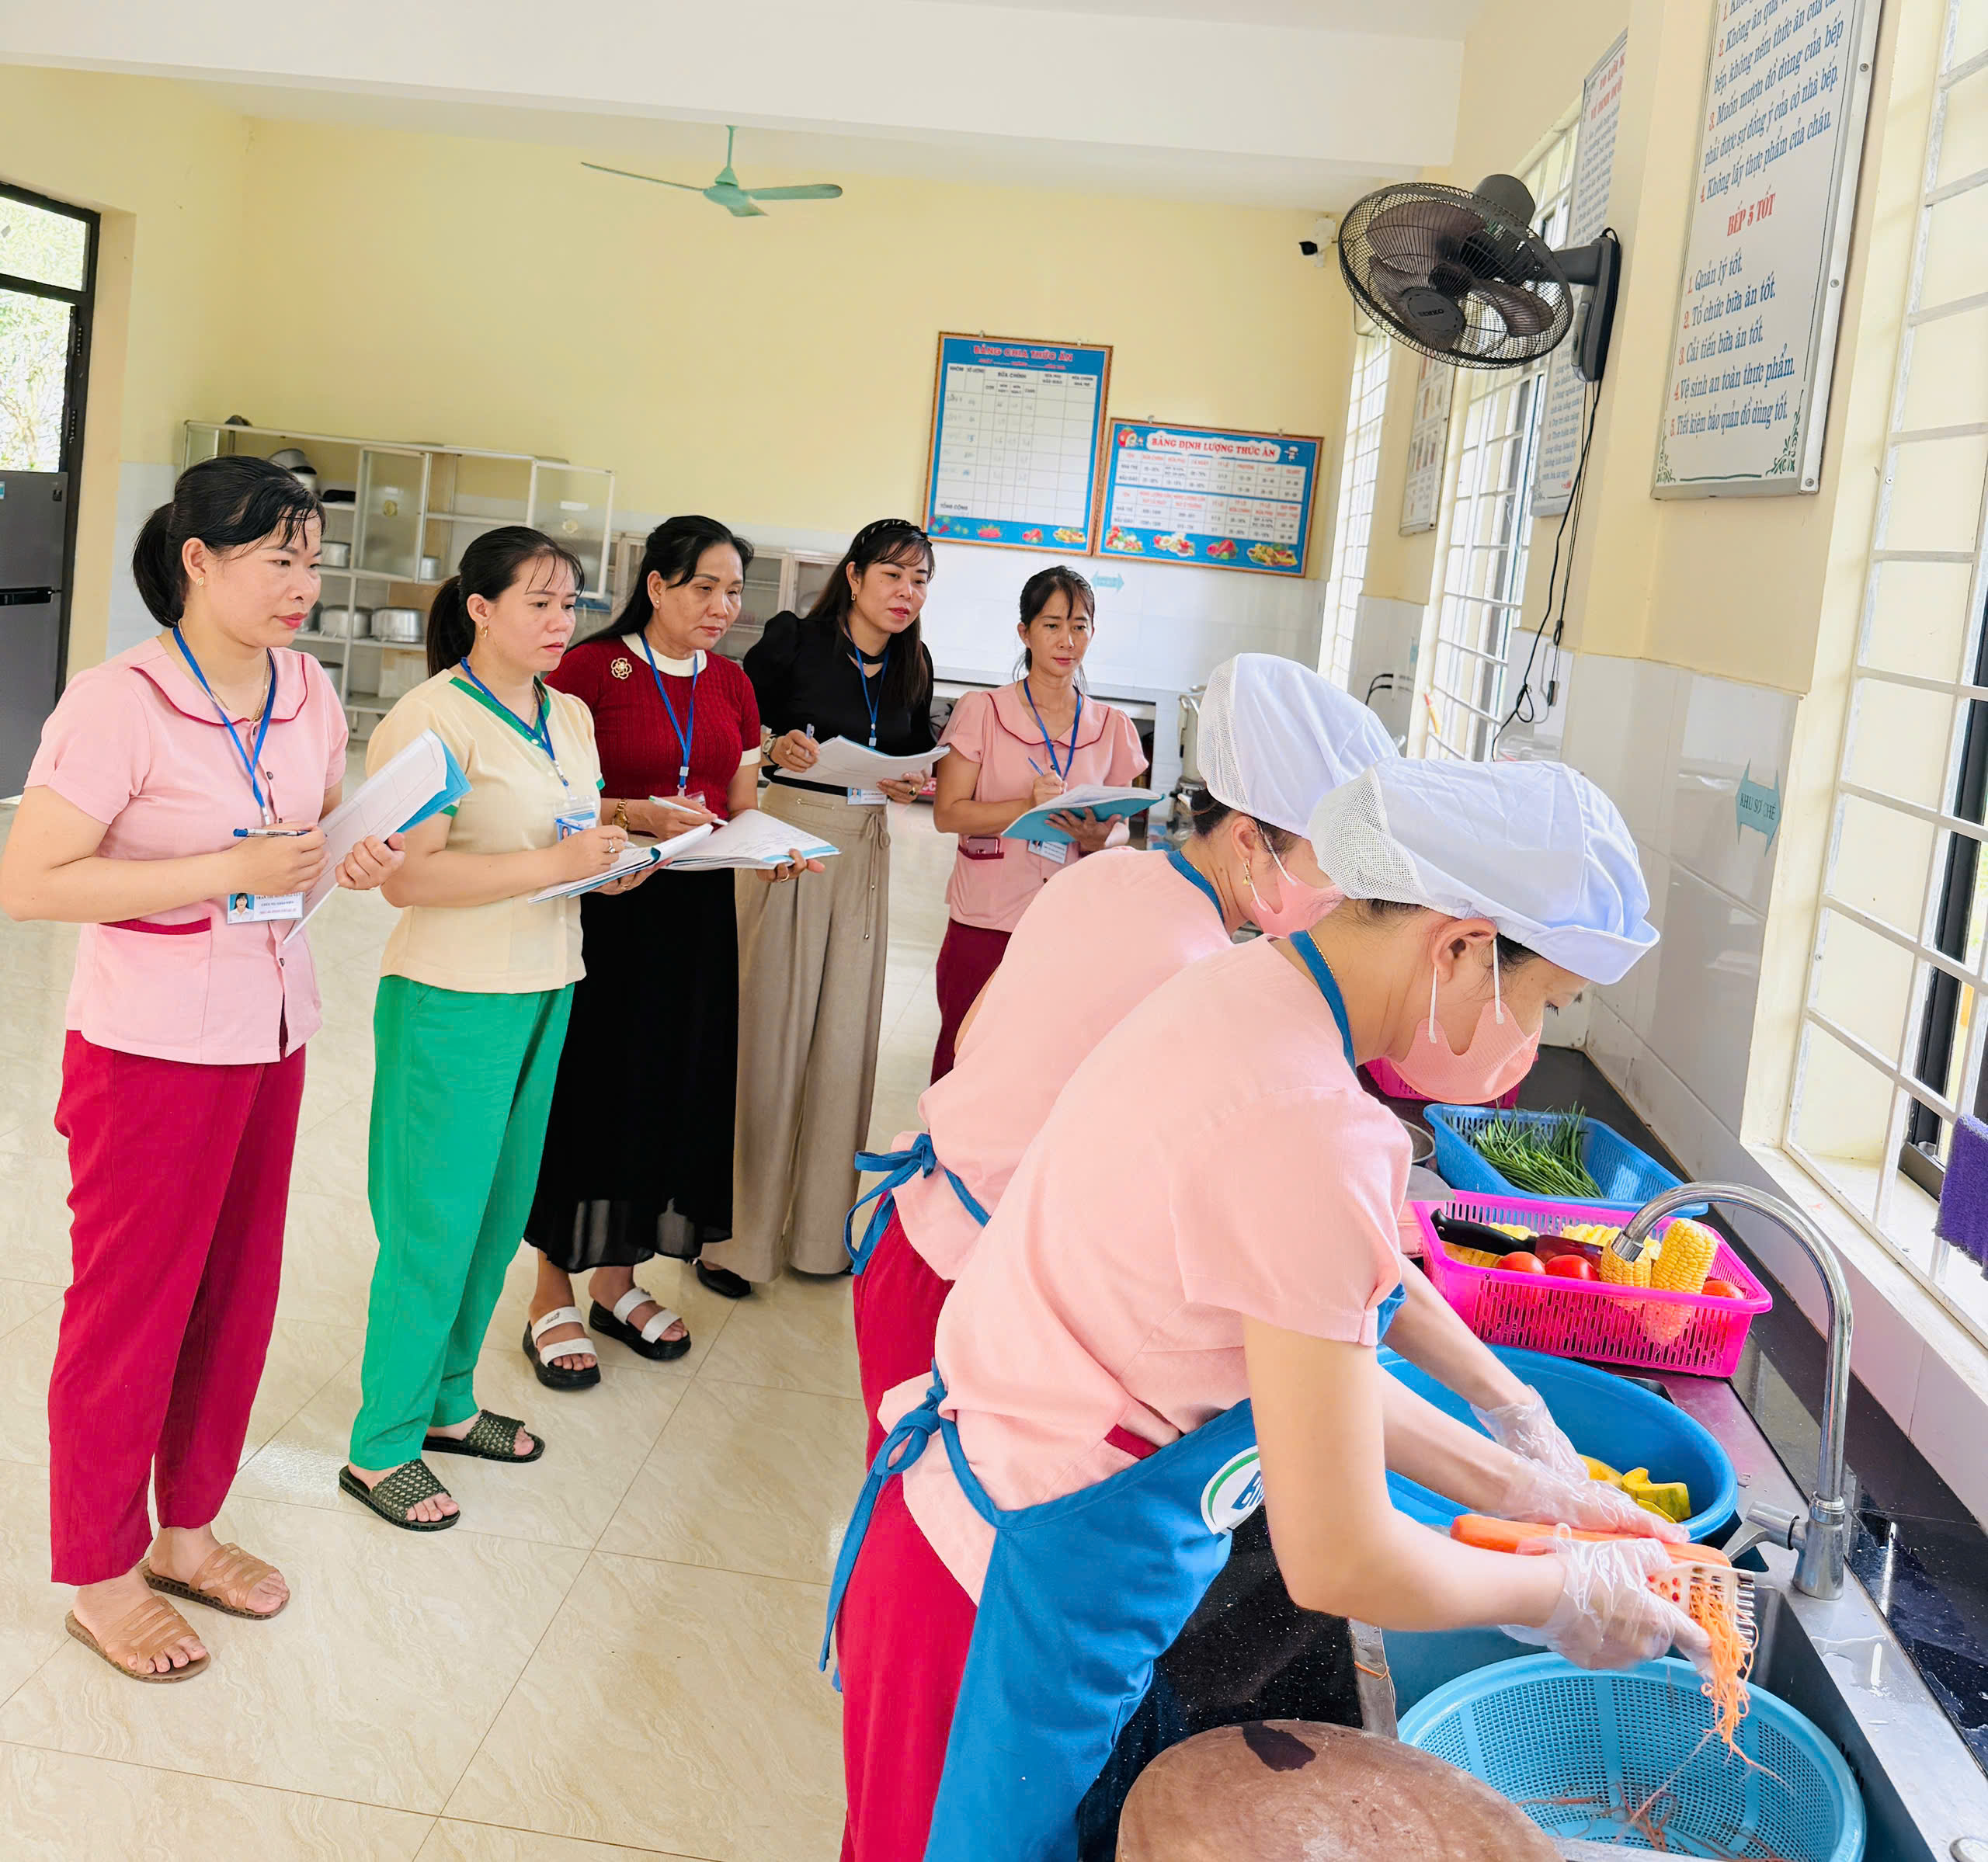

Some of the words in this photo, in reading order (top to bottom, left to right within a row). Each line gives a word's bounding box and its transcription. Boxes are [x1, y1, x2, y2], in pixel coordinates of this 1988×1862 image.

[1726, 20, 1751, 52] Không
[1778, 50, 1802, 81] dùng
[1805, 28, 1822, 62] của
[1824, 11, 1844, 47] bếp
[1729, 50, 1753, 83] không
[1774, 89, 1788, 122] của
[1802, 71, 1818, 104] nhà
[1706, 172, 1730, 200] Không
[1789, 117, 1805, 151] của
[1727, 200, 1746, 237] BẾP
[1757, 184, 1776, 222] TỐT
[1694, 259, 1716, 291] Quản
[1717, 255, 1728, 287] lý
[1692, 294, 1705, 327] Tổ
[1703, 296, 1724, 323] chức
[1726, 290, 1742, 316] bữa
[1744, 283, 1757, 308] ăn
[973, 343, 1002, 356] BẢNG
[1004, 347, 1029, 359] CHIA
[1030, 349, 1056, 360] THỨC
[1058, 351, 1073, 362] ĂN
[1686, 335, 1700, 364] Cải
[1700, 331, 1716, 360] tiến
[1718, 330, 1733, 354] bữa
[1735, 325, 1747, 349] ăn
[1680, 377, 1691, 405] Vệ
[1690, 374, 1708, 398] sinh
[1708, 376, 1719, 396] an
[1722, 364, 1741, 391] toàn
[1743, 361, 1764, 390] thực
[1677, 410, 1690, 436] Tiết
[1689, 412, 1706, 439] kiệm
[1707, 403, 1721, 431] bảo
[1721, 399, 1740, 436] quản
[1740, 395, 1753, 426] đồ
[1751, 398, 1774, 429] dùng
[1152, 436, 1177, 448] BẢNG
[1204, 440, 1234, 453] LƯỢNG
[1236, 444, 1260, 455] THỨC
[1263, 445, 1275, 457] ĂN
[1740, 792, 1753, 811] KHU
